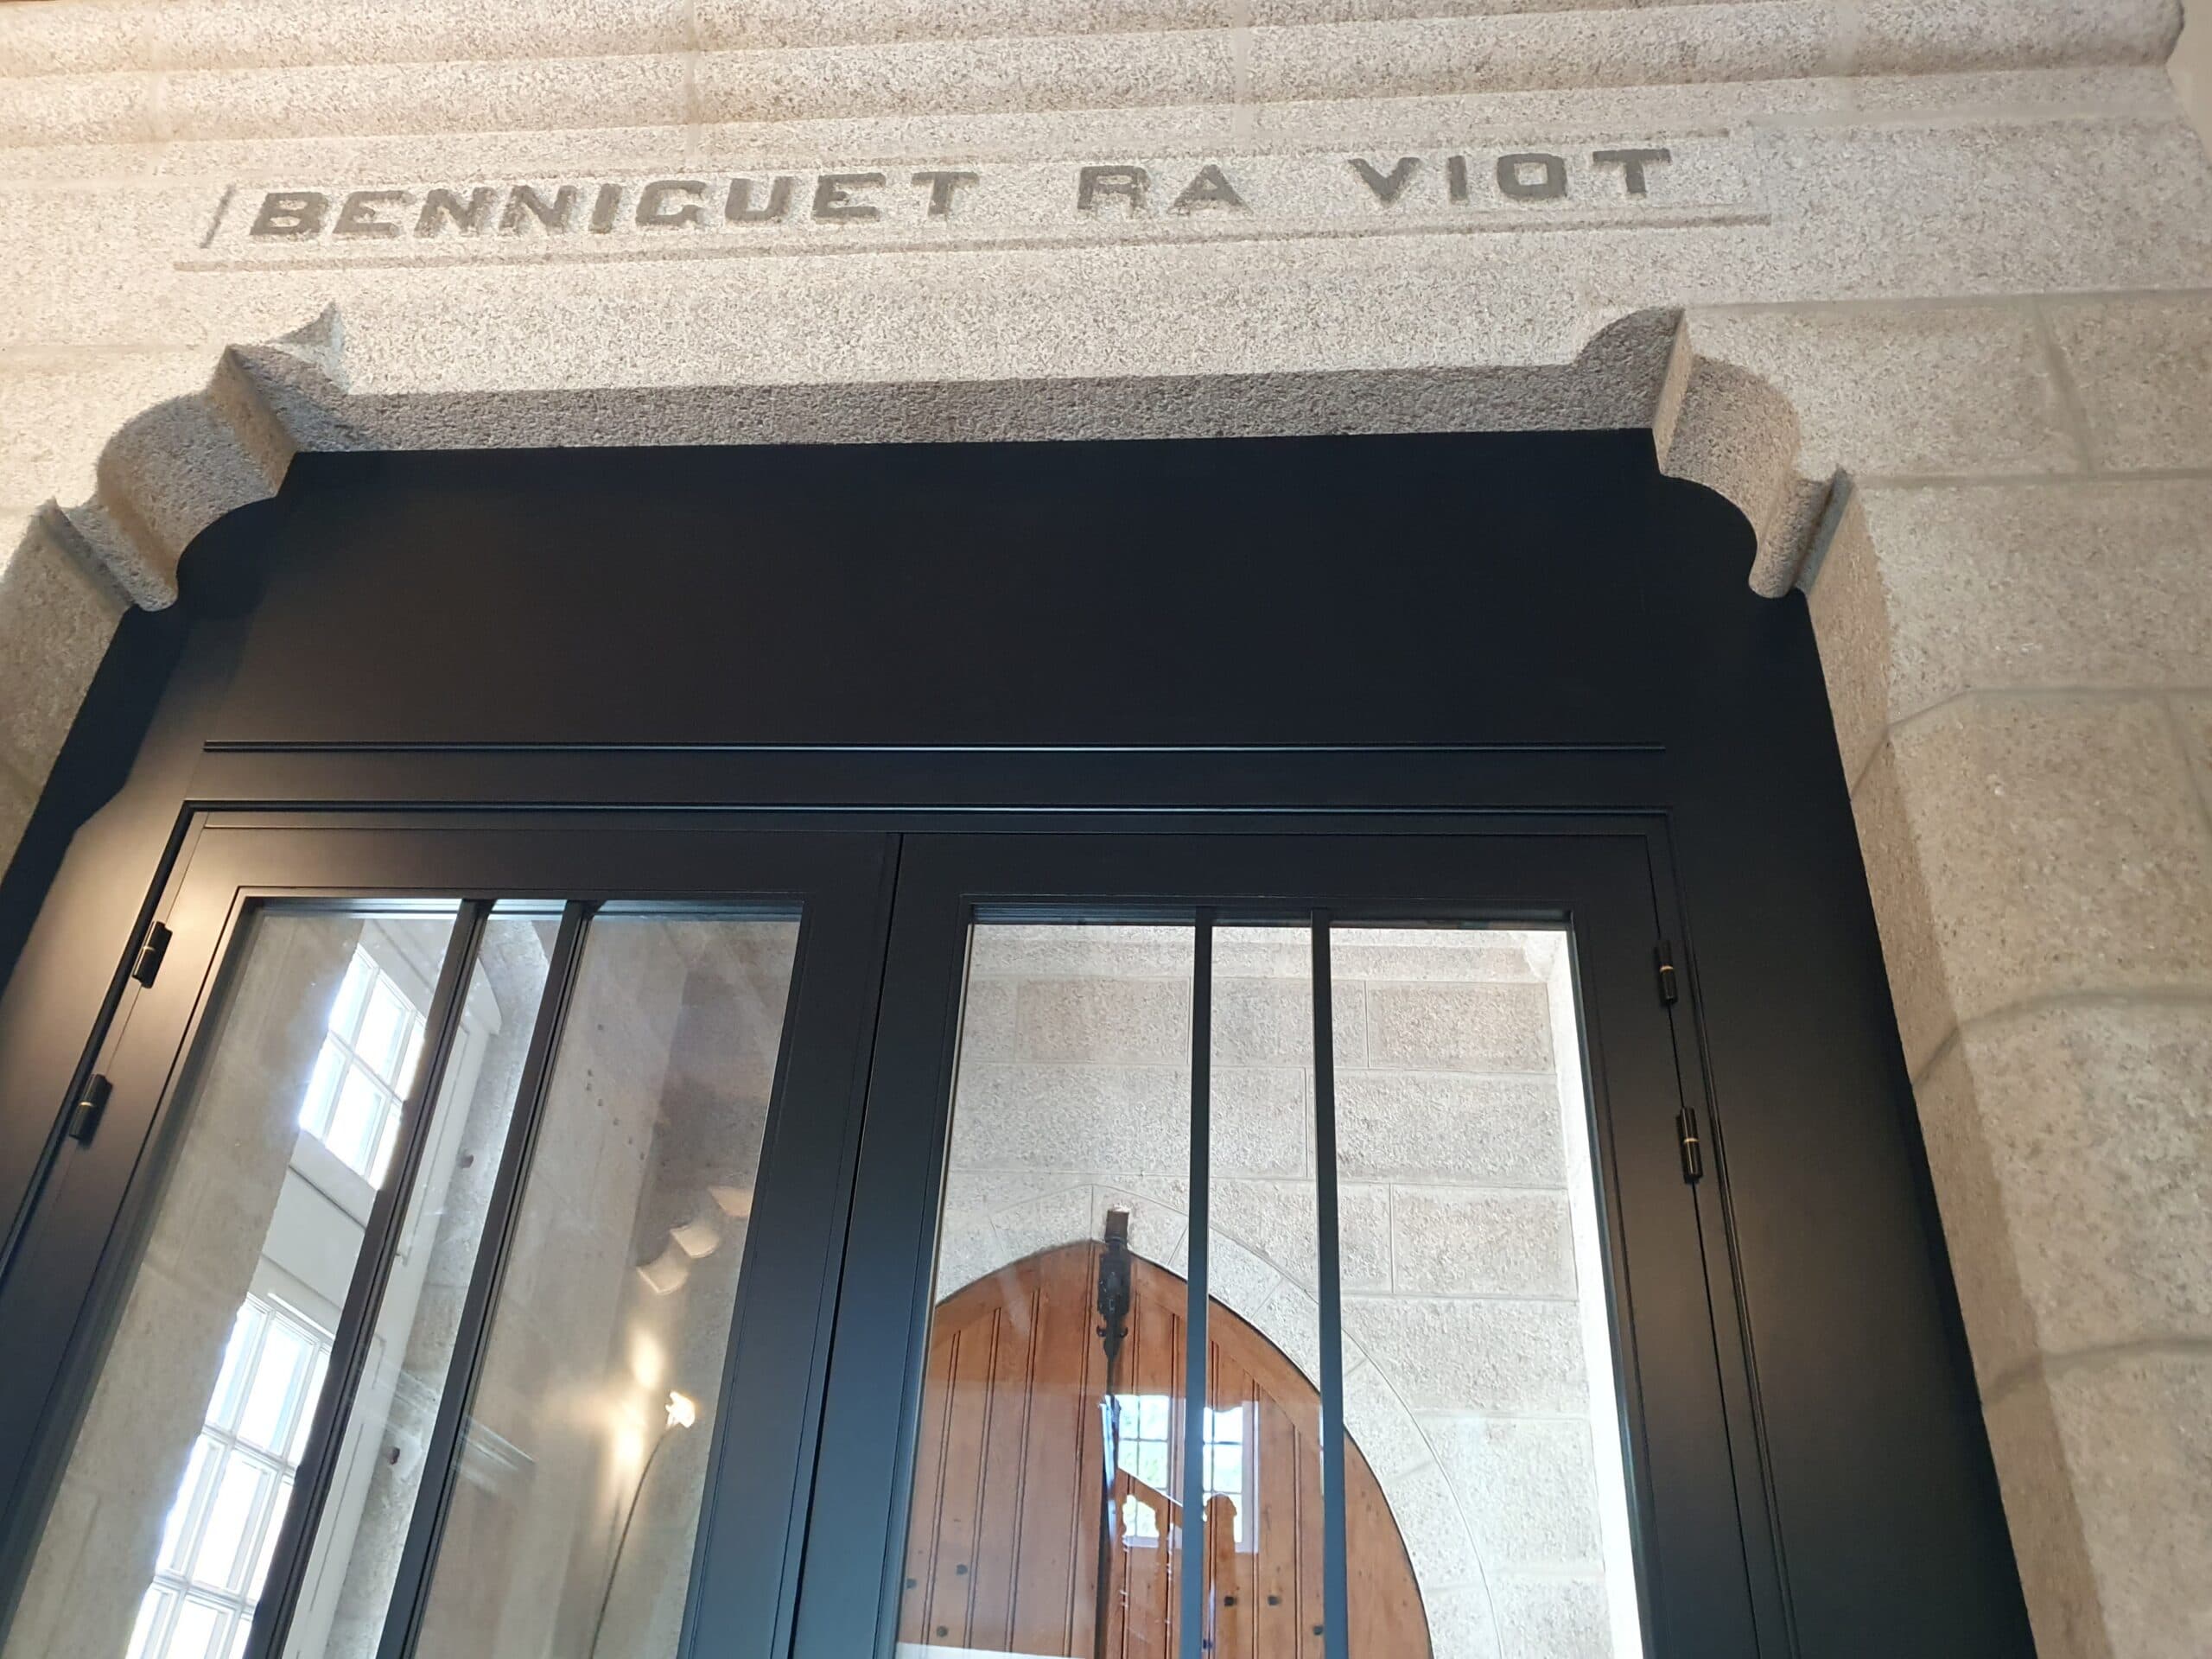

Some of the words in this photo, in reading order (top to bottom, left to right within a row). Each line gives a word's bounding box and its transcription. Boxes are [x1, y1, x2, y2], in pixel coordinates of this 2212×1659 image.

[249, 170, 980, 238] BENNIGUET
[1076, 164, 1252, 216] RA
[1348, 148, 1672, 202] VIOT
